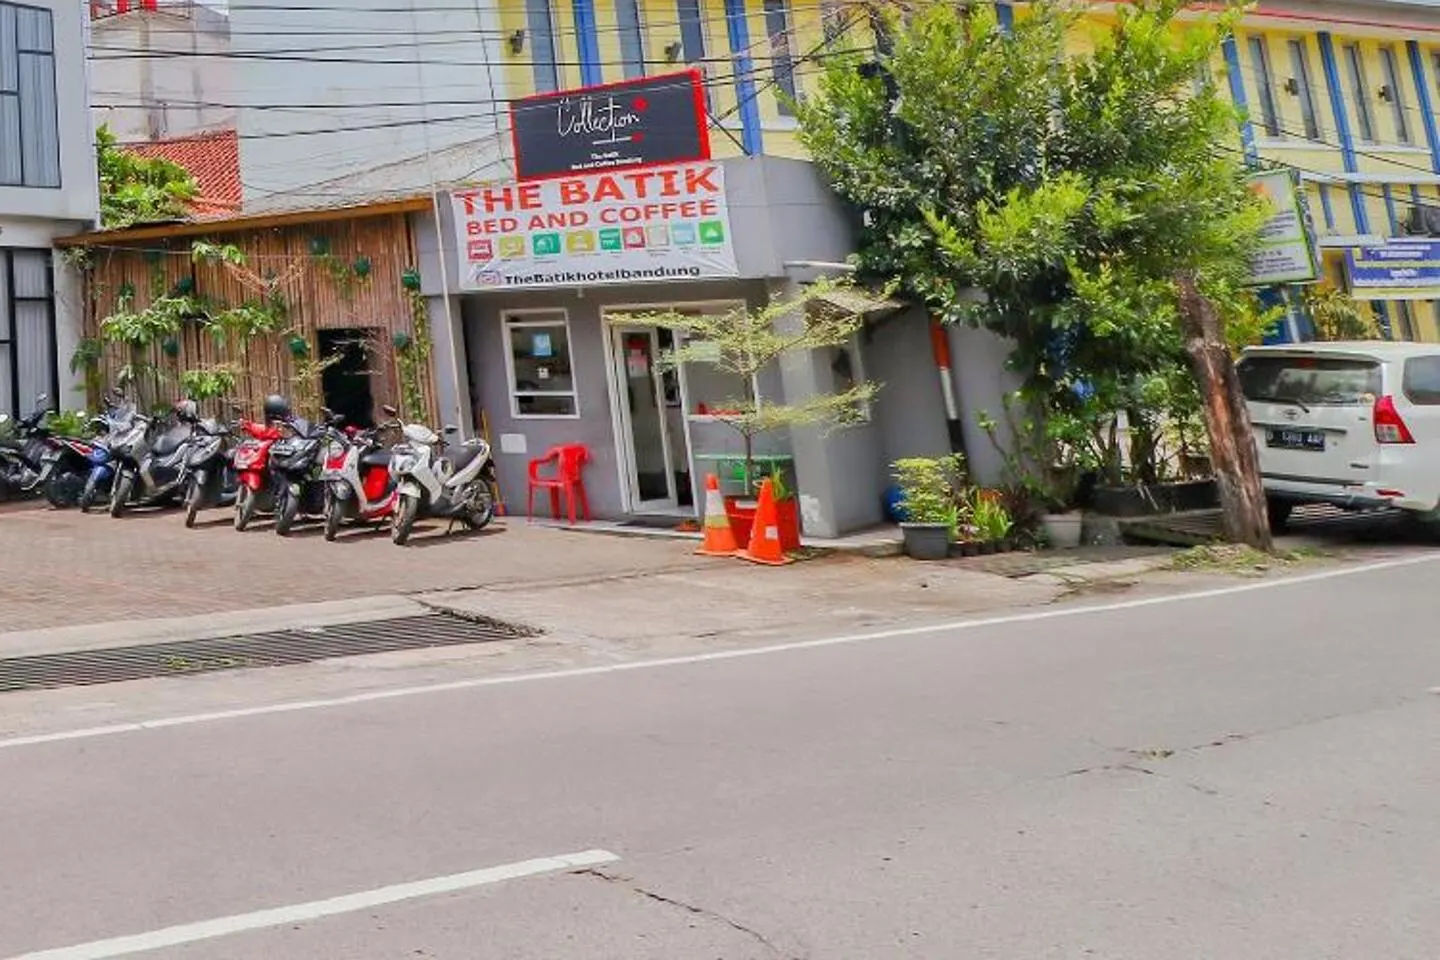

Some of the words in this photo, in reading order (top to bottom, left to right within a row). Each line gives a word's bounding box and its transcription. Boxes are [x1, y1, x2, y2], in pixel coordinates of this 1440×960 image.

[454, 183, 541, 215] THE
[559, 166, 721, 207] BATIK
[466, 217, 517, 236] BED
[527, 211, 589, 231] AND
[599, 199, 719, 225] COFFEE
